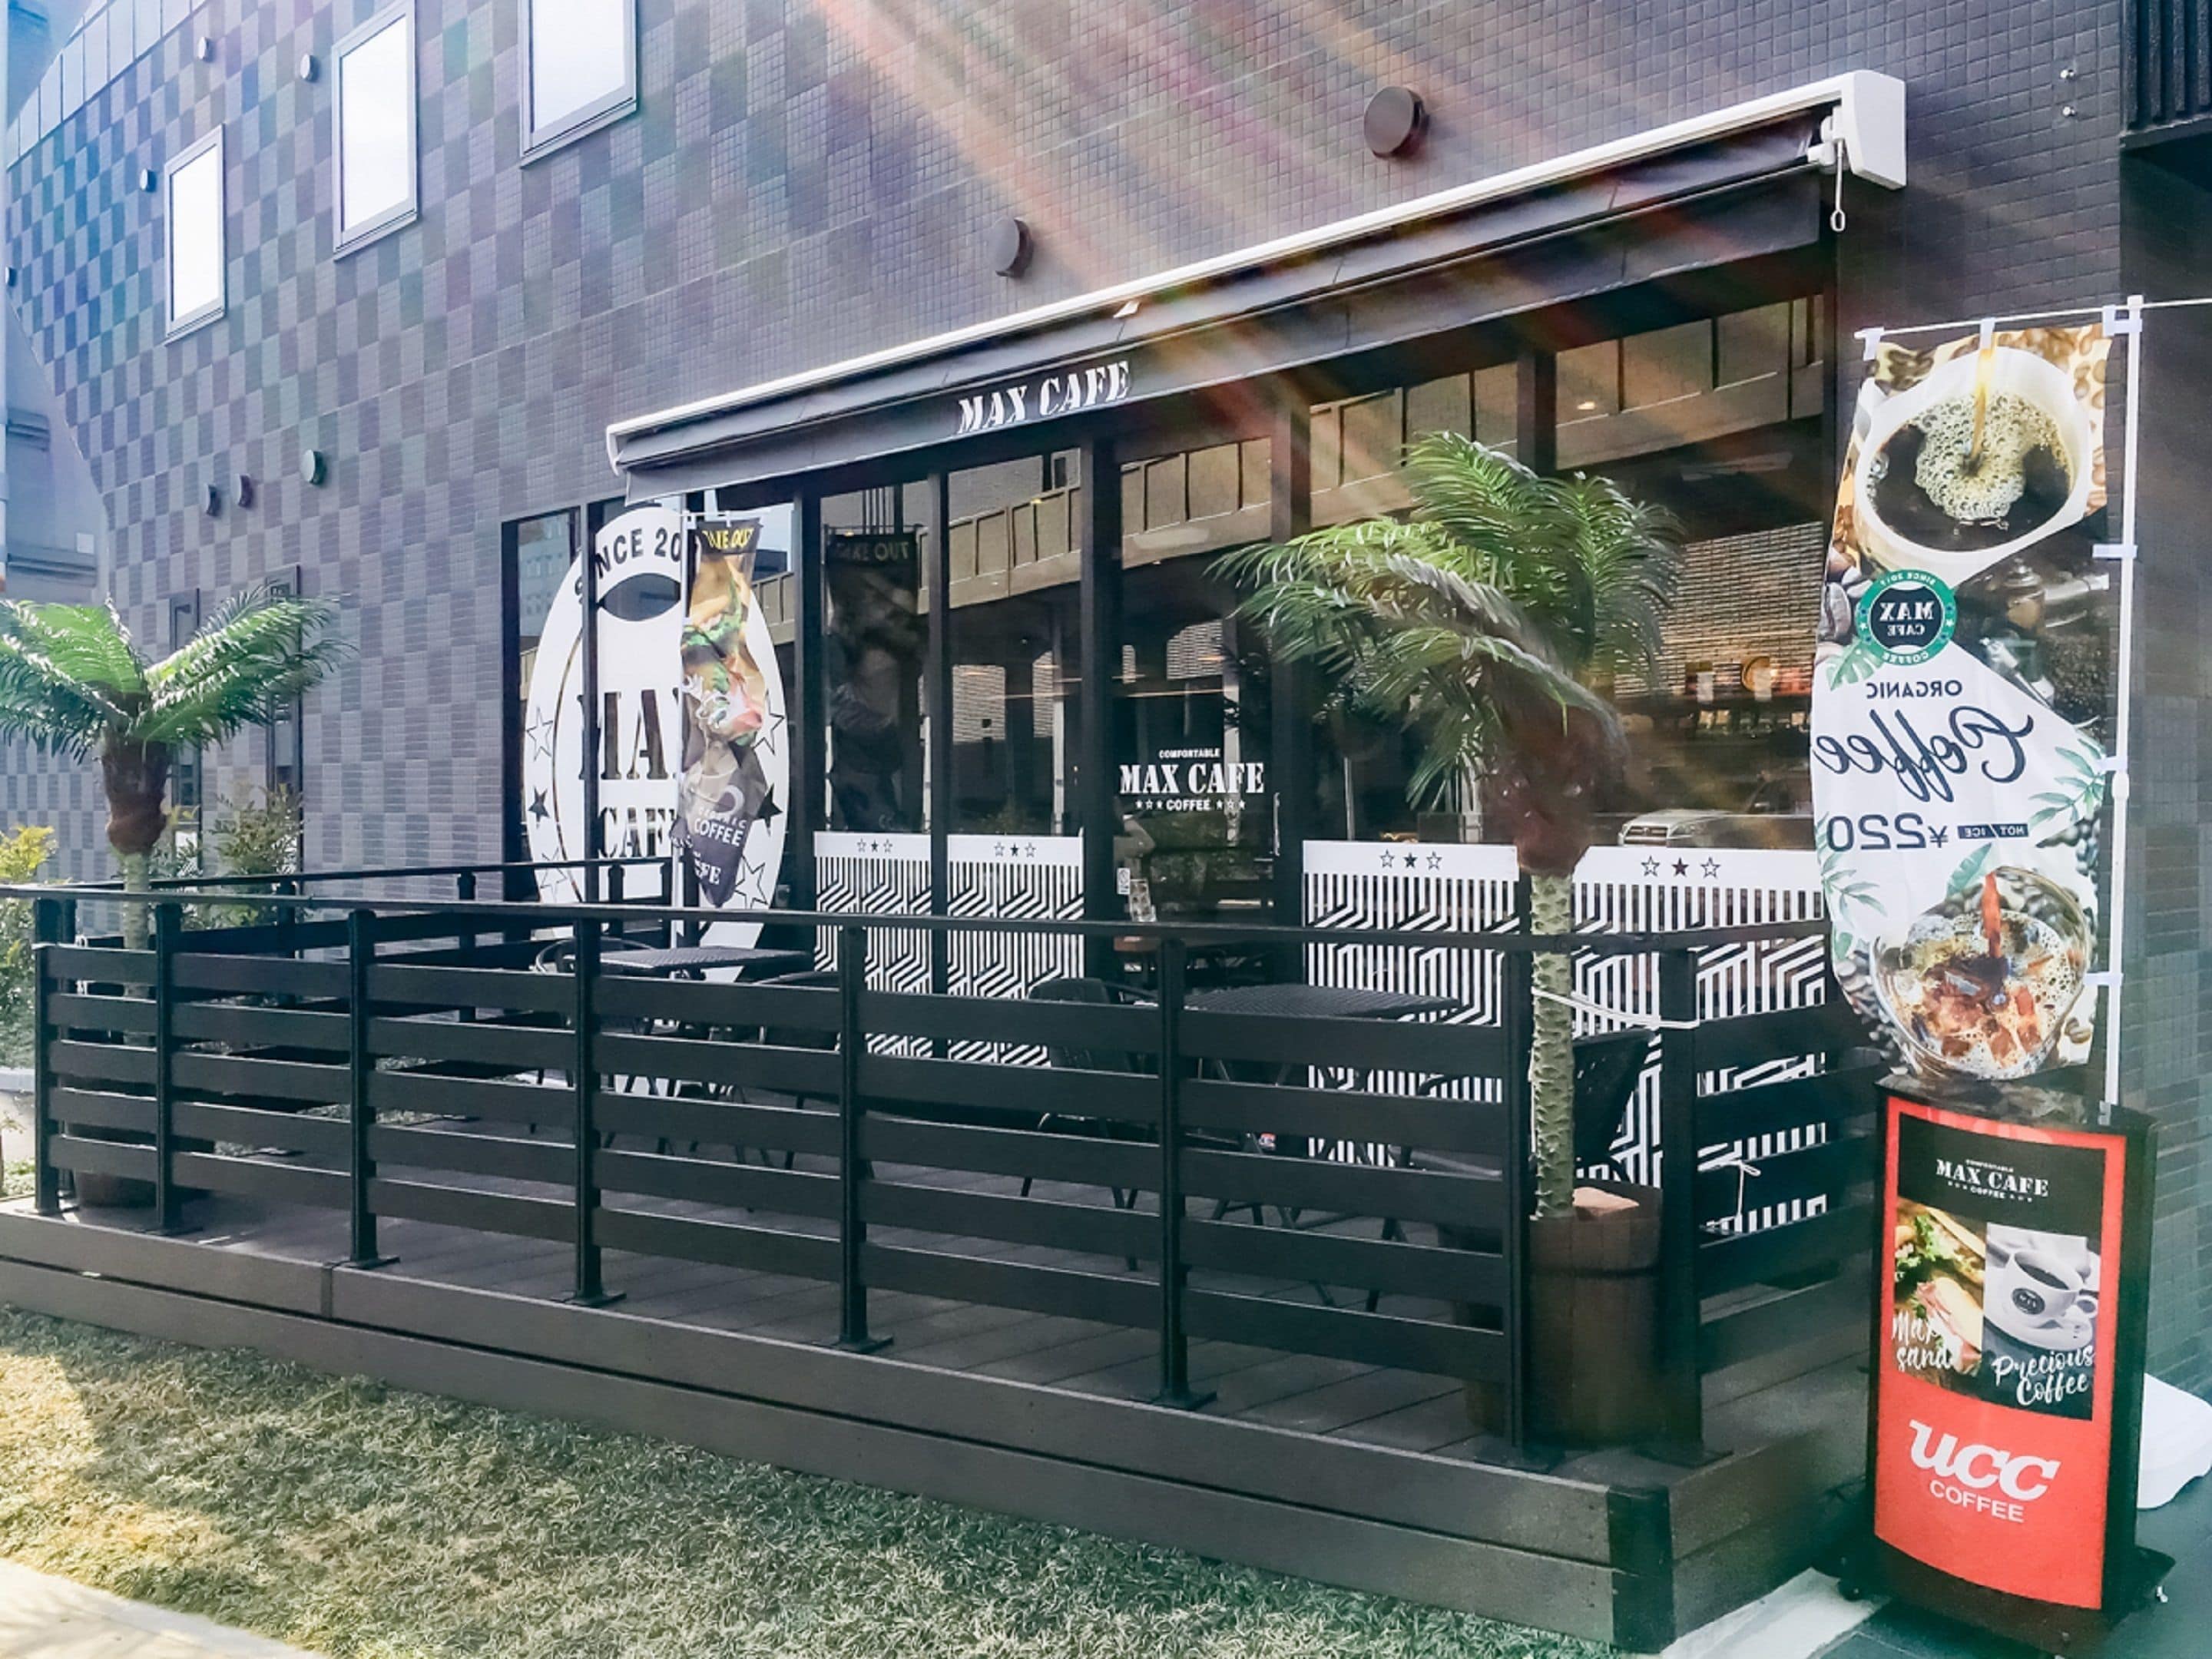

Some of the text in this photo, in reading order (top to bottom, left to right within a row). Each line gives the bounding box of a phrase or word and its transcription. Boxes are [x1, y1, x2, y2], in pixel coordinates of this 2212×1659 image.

[958, 360, 1129, 434] MAX CAFE
[874, 541, 909, 561] OUT
[1158, 748, 1220, 758] COMFORTABLE
[1119, 763, 1264, 794] MAX CAFE
[1166, 799, 1211, 811] COFFEE
[694, 818, 743, 846] COFFEE
[1936, 1158, 2049, 1197] MAX CAFE
[1970, 1186, 2005, 1199] COFFEE
[1992, 1345, 2095, 1386] Precious
[2016, 1373, 2089, 1406] Coffee
[1929, 1480, 2024, 1523] COFFEE
